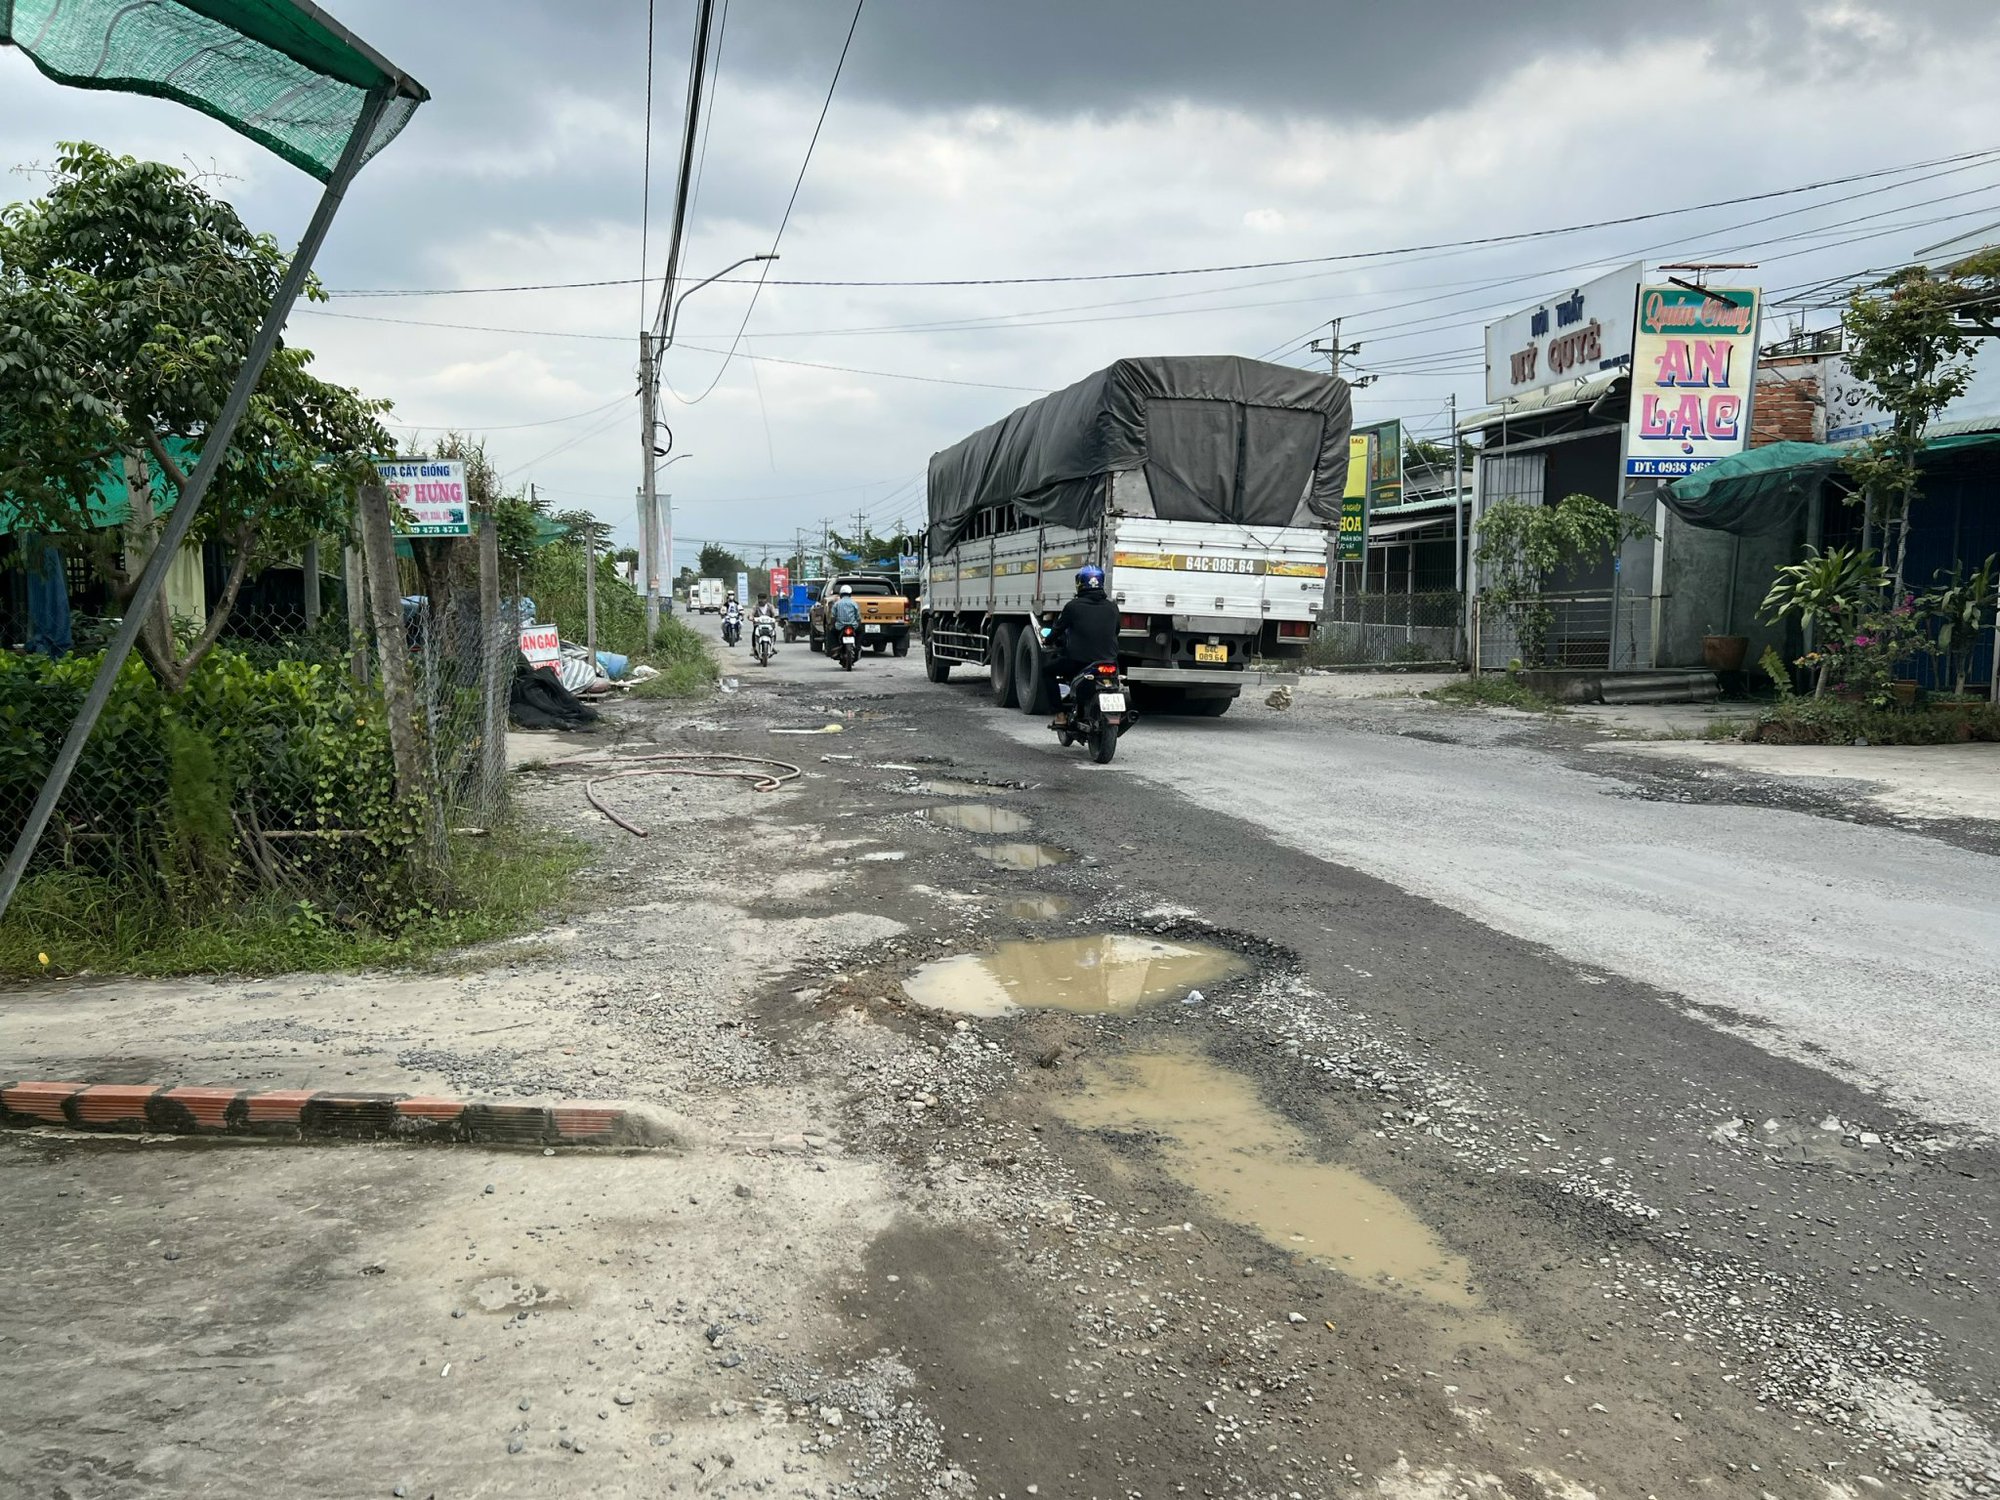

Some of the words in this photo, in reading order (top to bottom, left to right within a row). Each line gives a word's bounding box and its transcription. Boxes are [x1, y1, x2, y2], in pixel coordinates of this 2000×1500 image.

[1654, 340, 1734, 388] AN
[1638, 394, 1741, 454] LẠC
[400, 464, 418, 478] CÂY
[420, 462, 450, 477] GIỐNG
[1658, 461, 1687, 474] 0938
[1185, 555, 1255, 574] 64C-089.64
